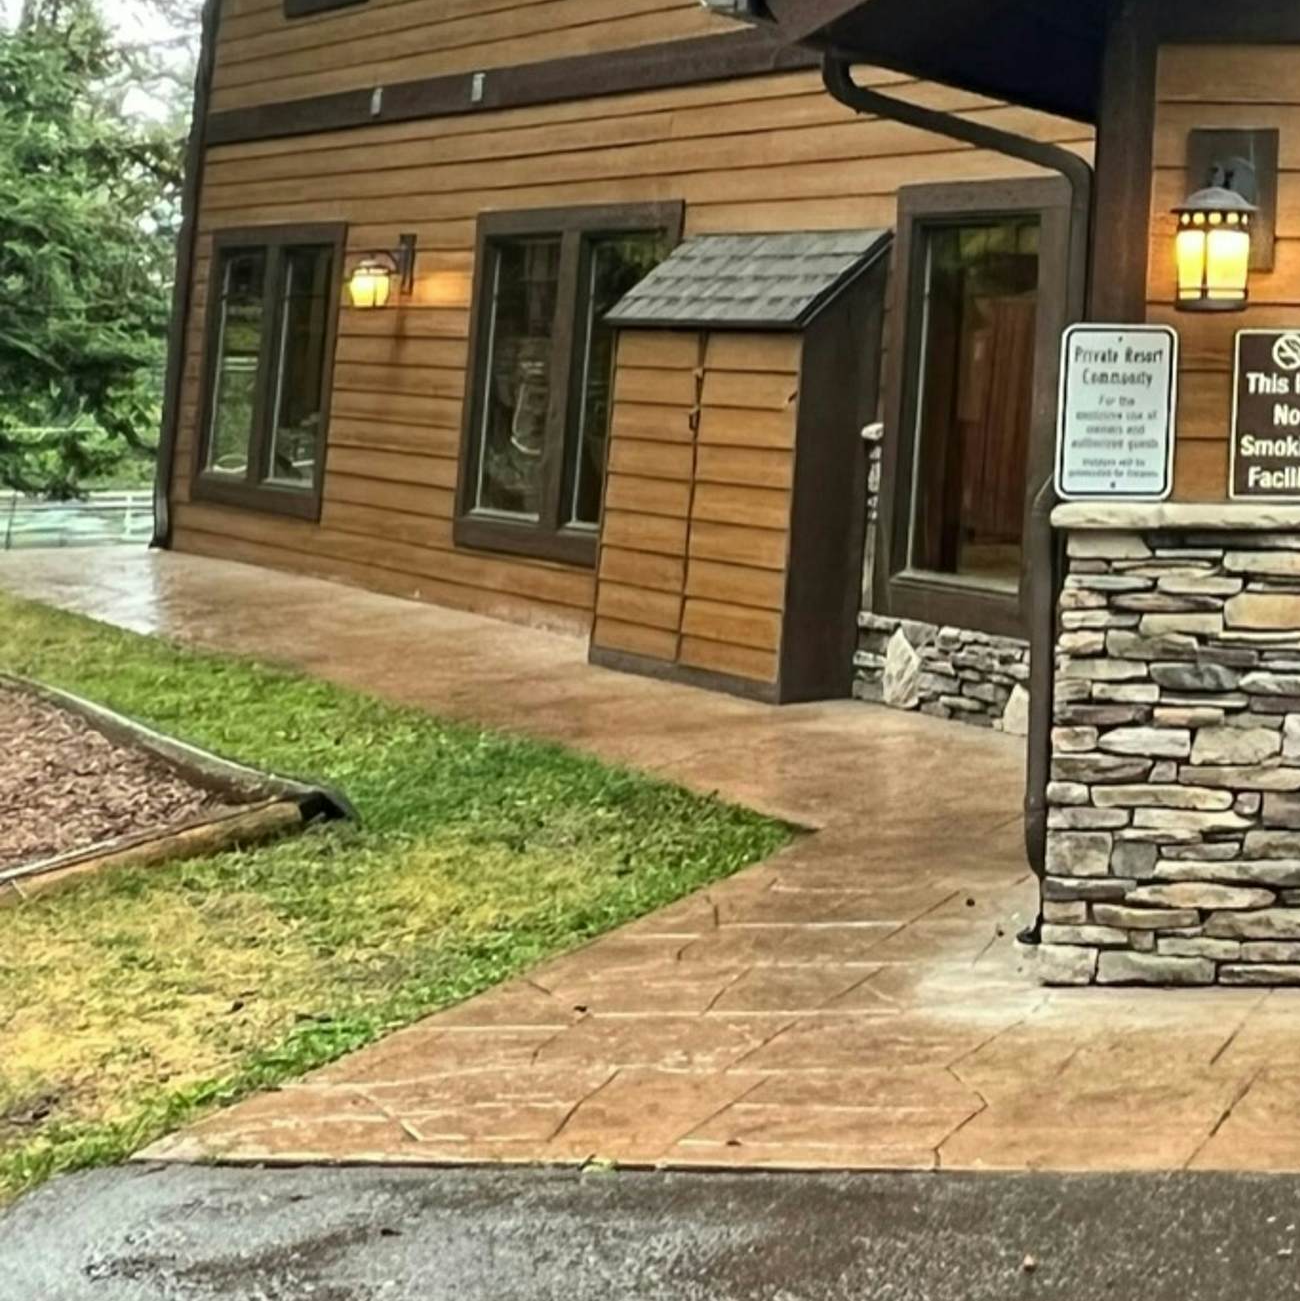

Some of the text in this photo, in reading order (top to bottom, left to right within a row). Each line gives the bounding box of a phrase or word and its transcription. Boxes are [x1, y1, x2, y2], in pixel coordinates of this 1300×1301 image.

[1074, 346, 1163, 363] Private Resort
[1246, 373, 1290, 395] This
